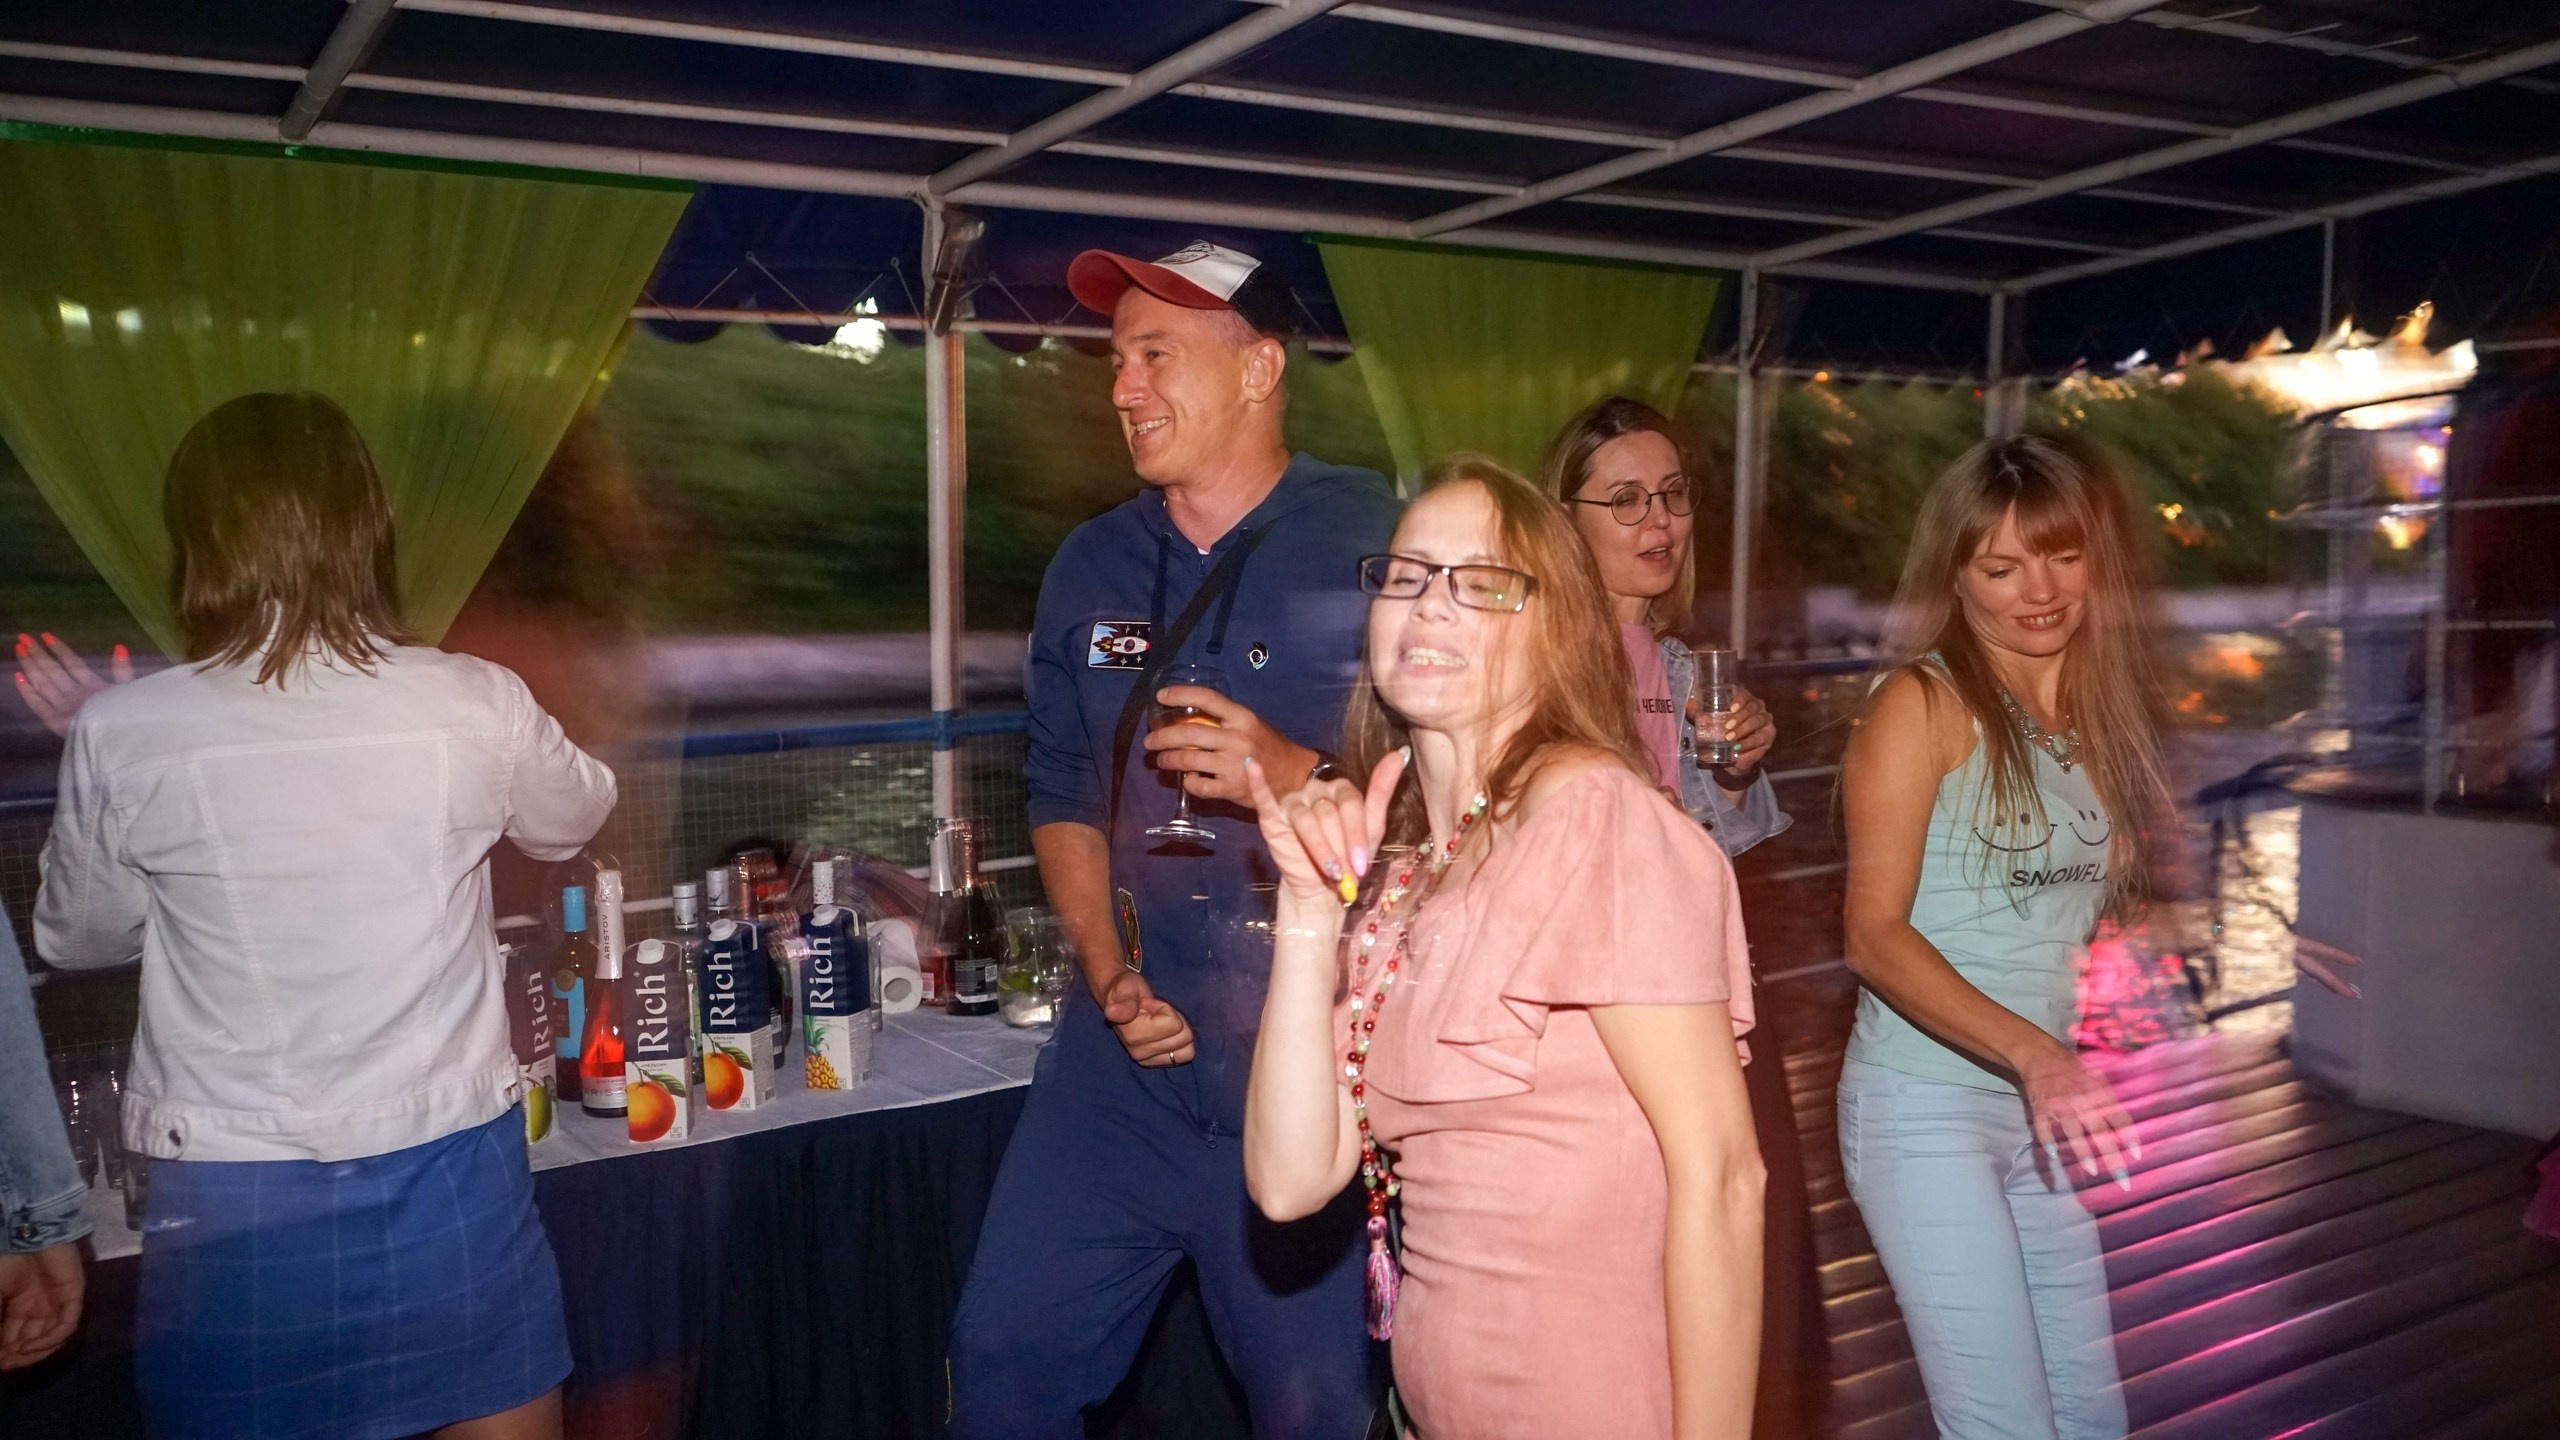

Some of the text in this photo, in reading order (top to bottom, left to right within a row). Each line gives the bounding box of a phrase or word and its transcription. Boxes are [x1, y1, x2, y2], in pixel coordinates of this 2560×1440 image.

[602, 914, 610, 960] ARISTOV
[808, 936, 834, 1010] Rich
[527, 971, 550, 1054] Rich
[635, 973, 669, 1054] Rich
[707, 951, 736, 1027] Rich
